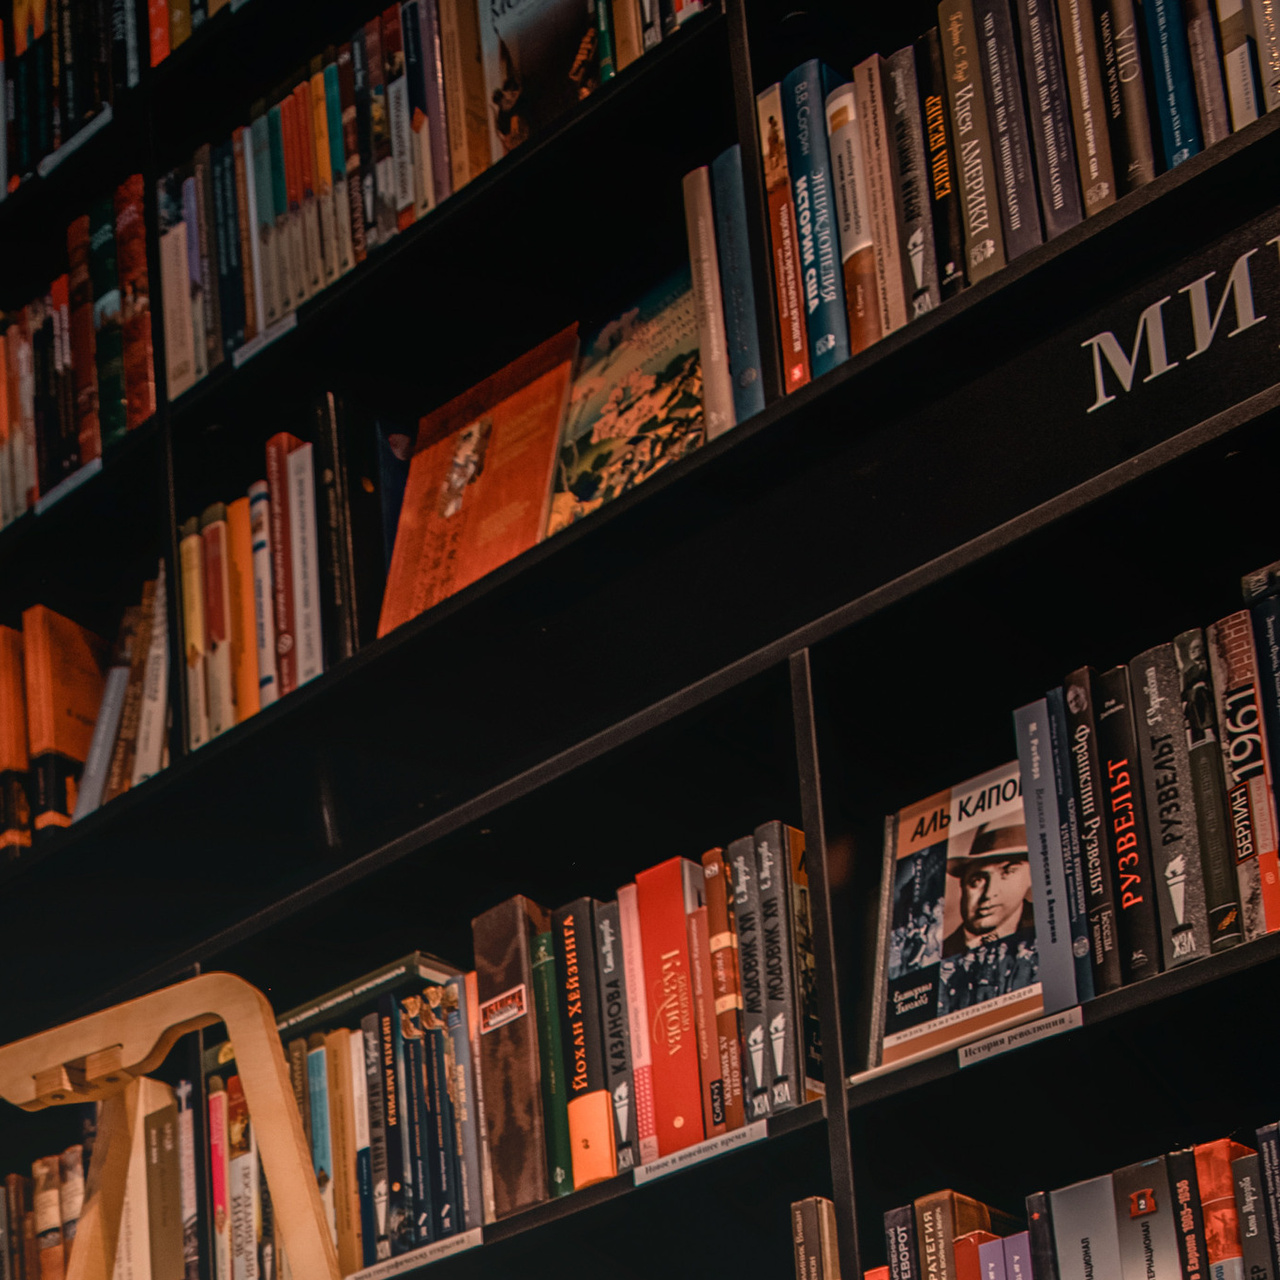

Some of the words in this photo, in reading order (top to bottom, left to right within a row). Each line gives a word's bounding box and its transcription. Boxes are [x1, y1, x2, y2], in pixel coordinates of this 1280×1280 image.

[954, 84, 975, 136] Идея
[962, 139, 988, 237] АМЕРИКИ
[1000, 135, 1018, 178] США
[795, 175, 816, 264] ИСТОРИИ
[810, 167, 837, 302] ЭНЦИКЛОПЕДИЯ
[805, 267, 819, 314] США
[1081, 236, 1280, 414] МИ
[1072, 725, 1098, 815] Франклин
[1225, 687, 1265, 782] 1961
[911, 811, 951, 841] АЛЬ
[1151, 733, 1183, 846] РУЗВЕЛЬТ
[1231, 788, 1254, 858] БЕРЛИН
[1084, 818, 1104, 895] Рузвельт
[1107, 759, 1143, 910] РУЗВЕЛЬТ
[383, 1016, 396, 1066] ПИРАТЫ
[606, 980, 629, 1074] КАЗАНОВА
[964, 1039, 1006, 1057] История
[1007, 1016, 1066, 1040] революции
[386, 1069, 397, 1126] АМЕРИКИ
[646, 1160, 668, 1173] Новое
[678, 1141, 718, 1160] новейшее
[721, 1131, 746, 1145] время
